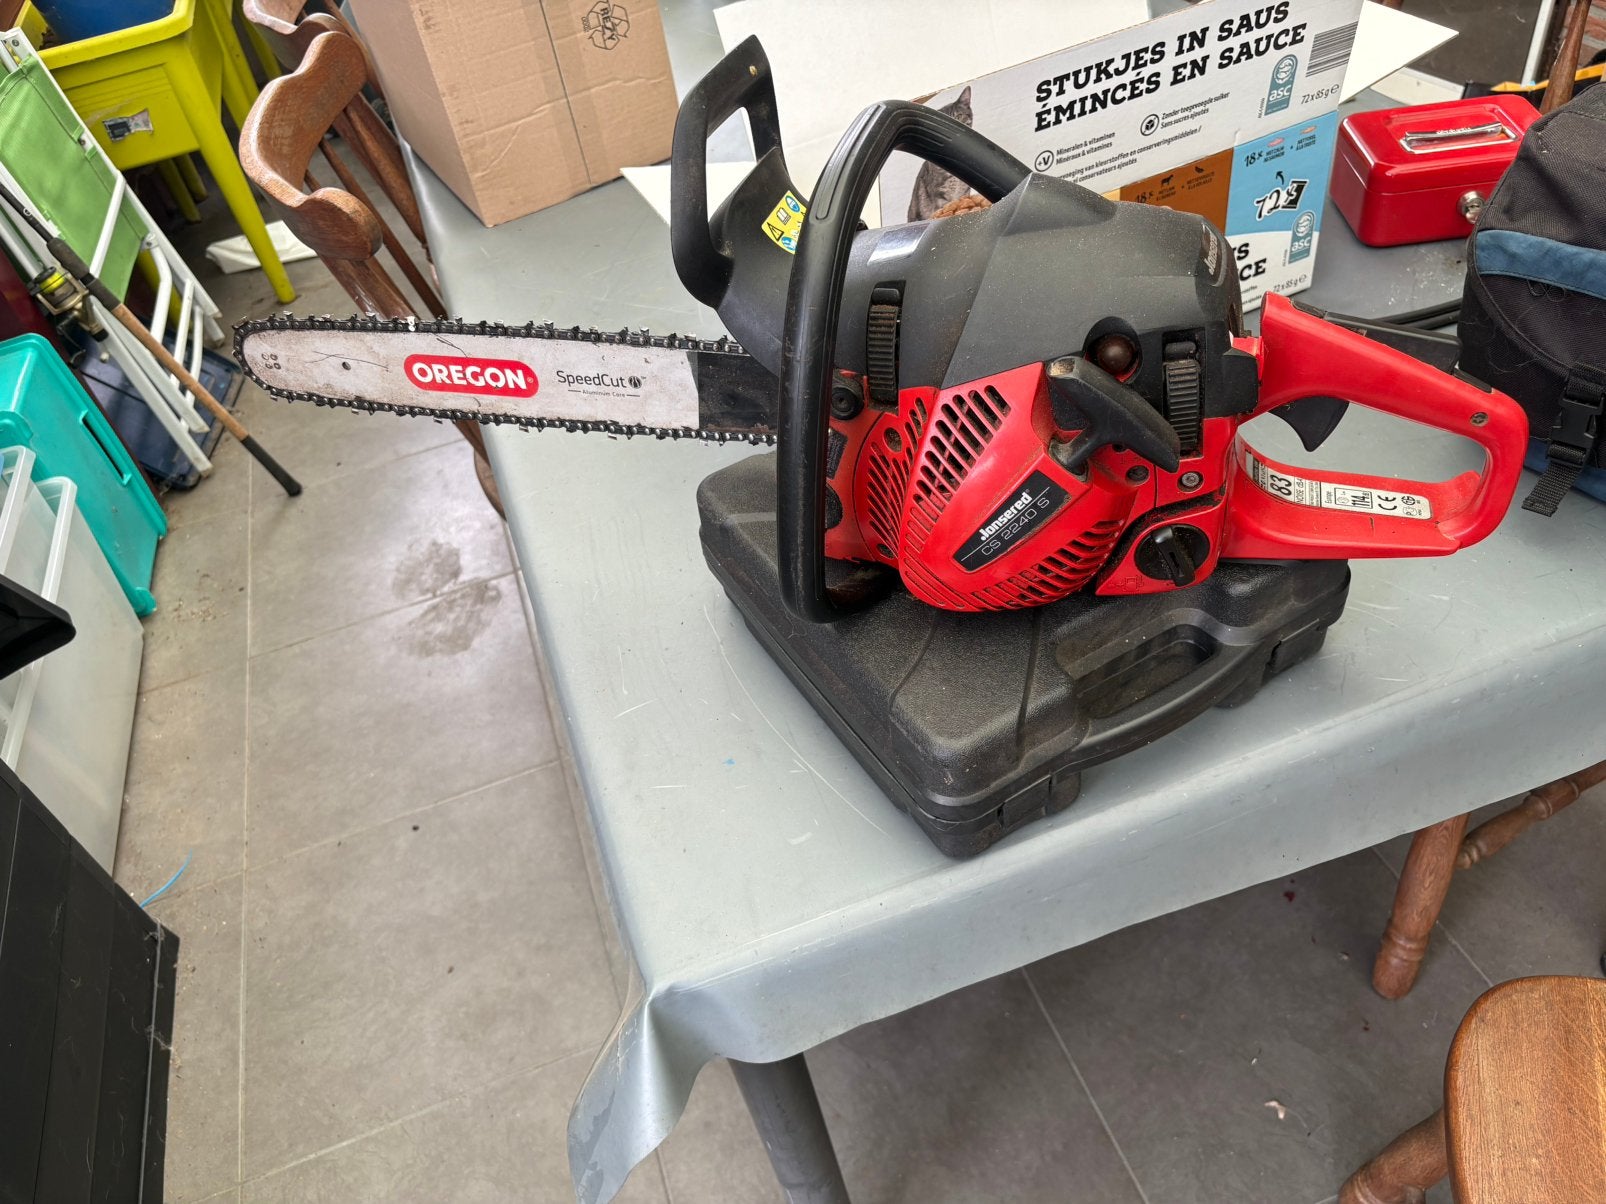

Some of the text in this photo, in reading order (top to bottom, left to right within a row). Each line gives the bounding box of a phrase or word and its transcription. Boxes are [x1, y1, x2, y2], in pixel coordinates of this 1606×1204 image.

[1036, 1, 1290, 103] STUKJES IN SAUS
[1034, 22, 1307, 133] ÉMINCÉS EN SAUCE
[1269, 84, 1292, 101] asc
[1161, 92, 1230, 120] Zonder toegevoegde suiker
[1161, 108, 1209, 129] Sans sucres ajoutés
[1056, 143, 1083, 156] Mineralen
[1088, 132, 1116, 145] vitaminen
[1086, 142, 1113, 155] vitamines
[1095, 152, 1129, 168] kleurstoffen
[1079, 165, 1116, 182] conservateurs
[1291, 237, 1311, 252] asc
[412, 362, 528, 391] OREGON
[556, 370, 627, 388] SpeedCut
[1270, 474, 1292, 496] 83
[979, 492, 1033, 541] Jonsered
[981, 497, 1050, 556] CS 2240 S
